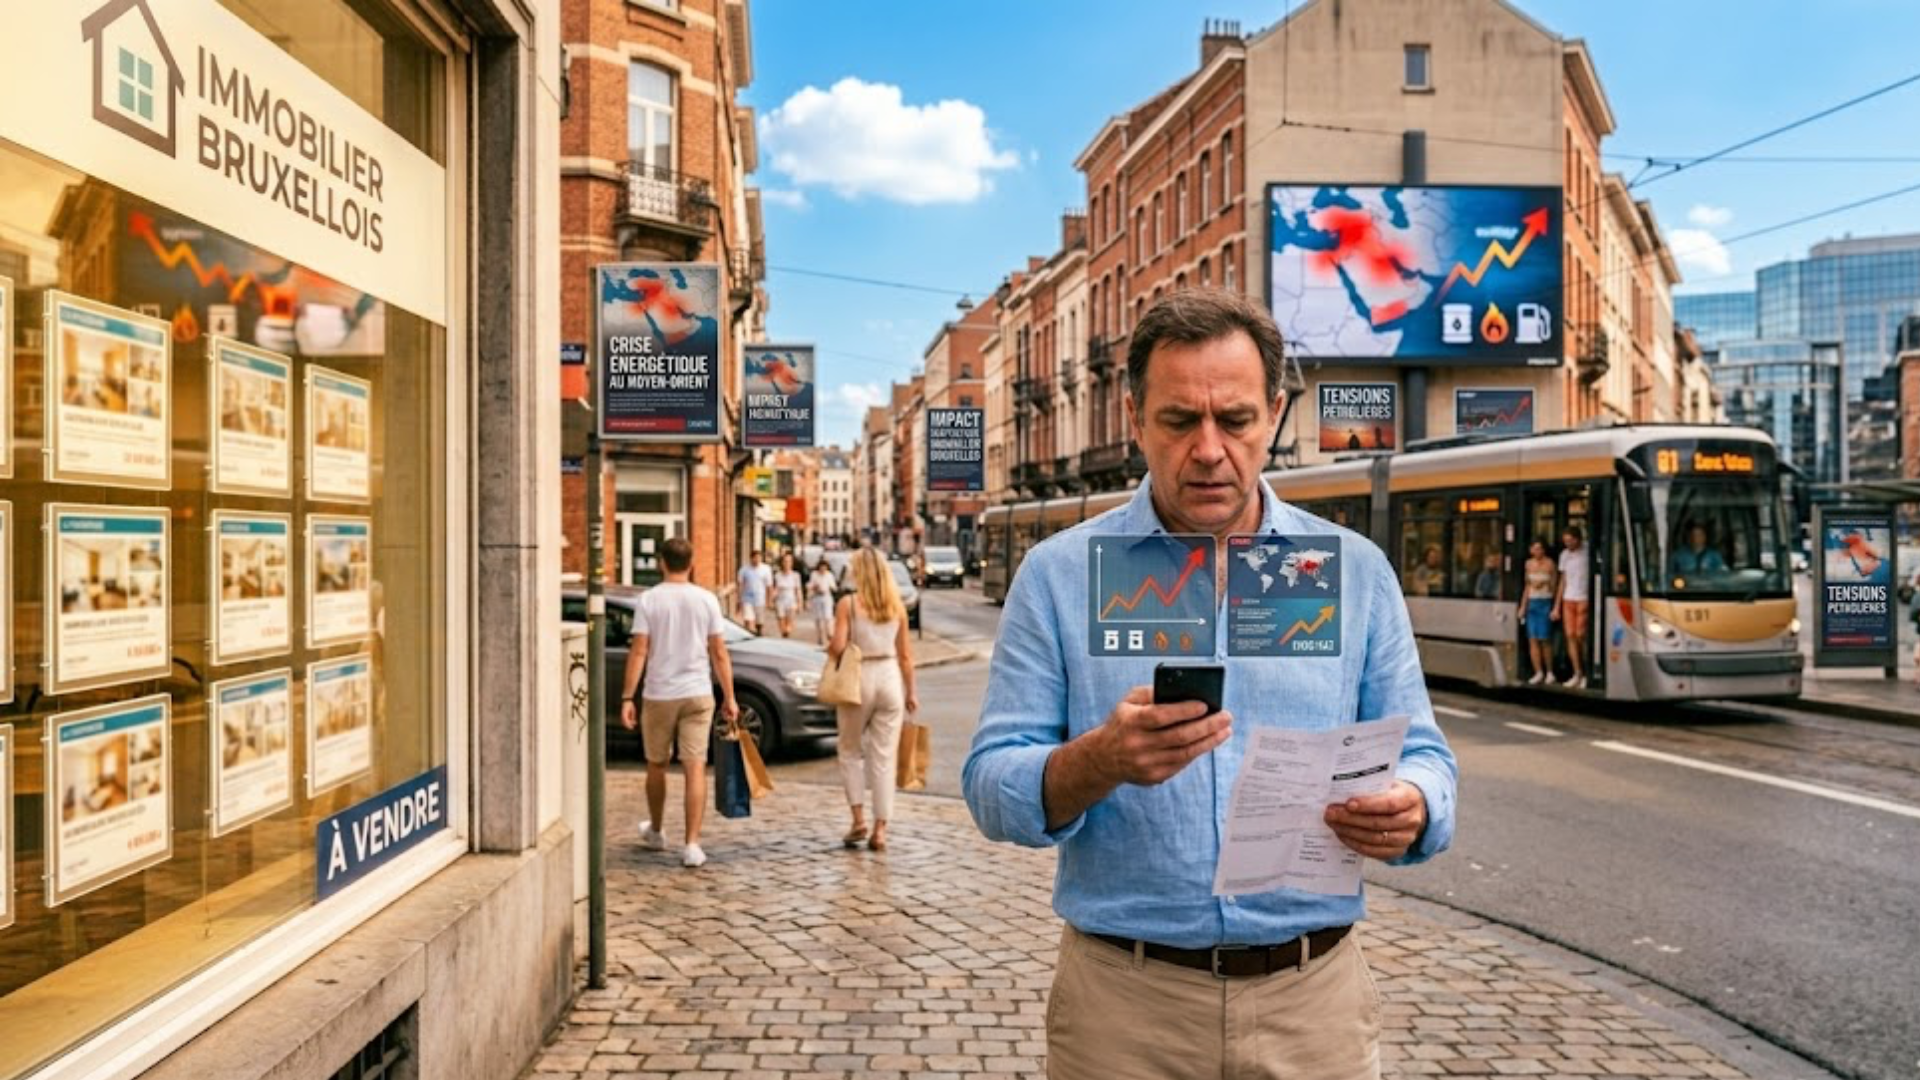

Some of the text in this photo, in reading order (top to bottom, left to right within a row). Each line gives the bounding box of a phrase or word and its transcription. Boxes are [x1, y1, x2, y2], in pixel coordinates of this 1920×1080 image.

[198, 44, 383, 203] IMMOBILIER
[198, 113, 383, 254] BRUXELLOIS
[609, 336, 652, 354] CRISE
[609, 375, 710, 389] AU MOYEN-ORIENT
[1323, 388, 1390, 404] TENSIONS
[931, 411, 981, 428] IMPACT
[1827, 586, 1887, 601] TENSIONS
[327, 781, 440, 881] À VENDRE
